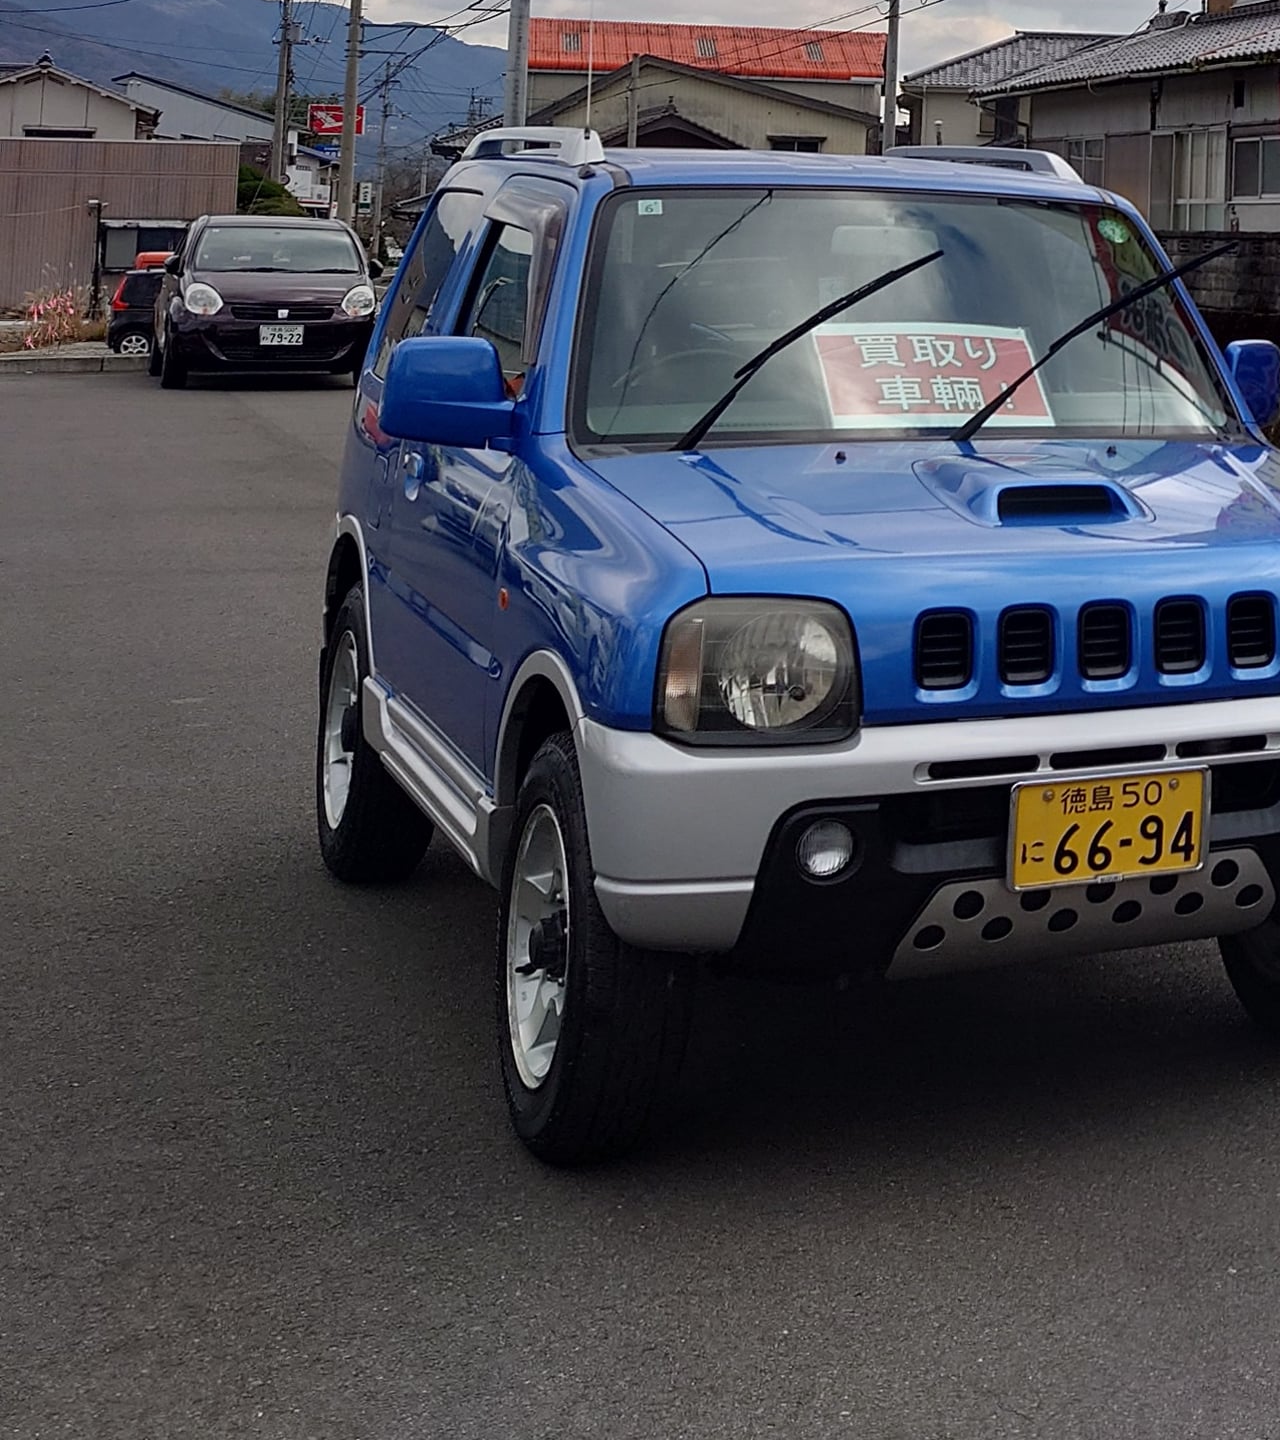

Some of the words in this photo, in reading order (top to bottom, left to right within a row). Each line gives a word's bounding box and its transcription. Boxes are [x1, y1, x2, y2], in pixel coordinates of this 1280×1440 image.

[269, 332, 302, 344] 79-22
[852, 334, 999, 371] 買取り
[1060, 786, 1115, 815] 徳島
[1121, 780, 1163, 809] 50
[1020, 841, 1045, 865] に
[1052, 810, 1196, 876] 66-94
